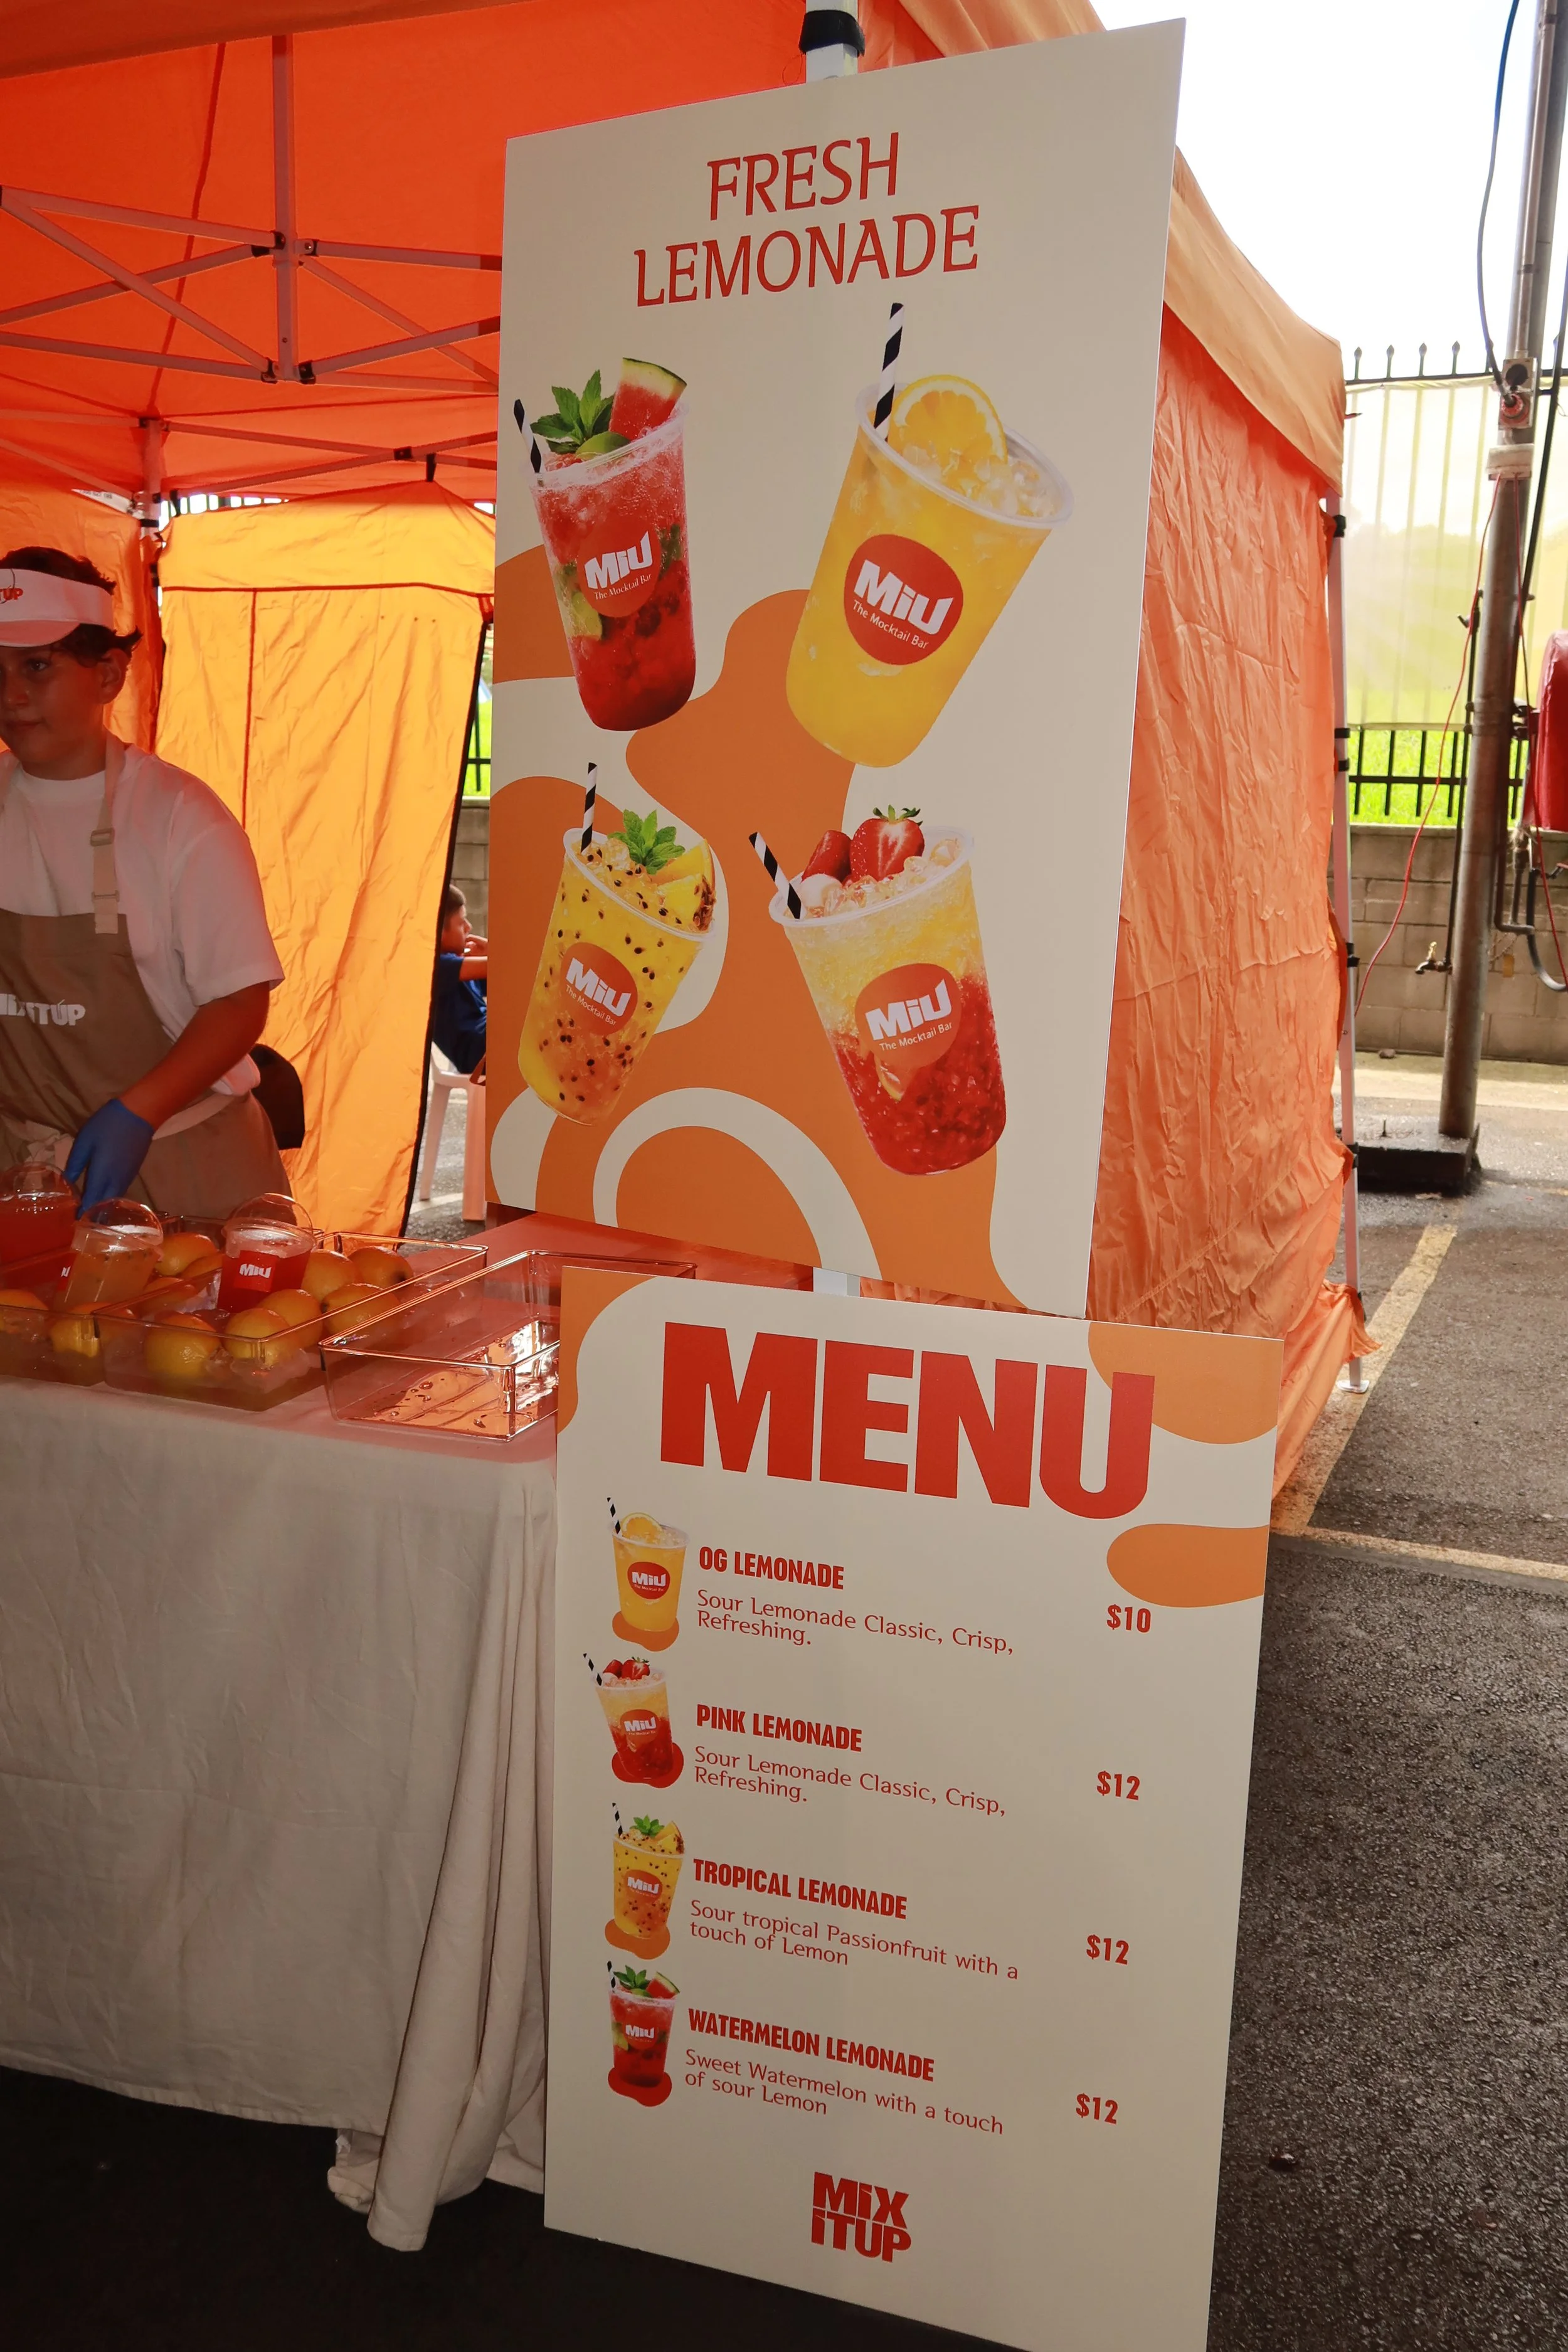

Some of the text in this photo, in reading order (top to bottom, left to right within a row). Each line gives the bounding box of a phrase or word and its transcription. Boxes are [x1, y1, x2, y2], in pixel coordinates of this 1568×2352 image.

[707, 132, 899, 221] FRESH
[634, 204, 979, 307] LEMONADE
[595, 573, 652, 600] The Mocktail Bar
[853, 600, 930, 649] The Mocktail Bar
[566, 984, 617, 1026] The Mocktail Bar
[879, 1022, 953, 1051] The Mocktail Bar
[660, 1322, 1155, 1519] MENU
[699, 1546, 844, 1590] OG LEMONADE
[697, 1589, 1014, 1655] Sour Lemonade Classic, Crisp,
[697, 1609, 812, 1646] Refreshing.
[1106, 1604, 1152, 1633] $10
[696, 1703, 862, 1752] PINK LEMONADE
[694, 1745, 1005, 1817] Sour Lemonade Classic, Crisp,
[694, 1766, 807, 1803] Refreshing.
[1096, 1771, 1141, 1801] $12
[692, 1858, 908, 1920] TROPICAL LEMONADE
[690, 1920, 849, 1966] touch of Lemon
[691, 1900, 1019, 1980] Sour tropical Passionfruit with a
[1086, 1934, 1130, 1966] $12
[688, 2008, 935, 2082] WATERMELON LEMONADE
[685, 2048, 1004, 2135] Sweet Watermelon with a touch
[685, 2072, 827, 2115] of sour Lemon
[1075, 2092, 1119, 2125] $12
